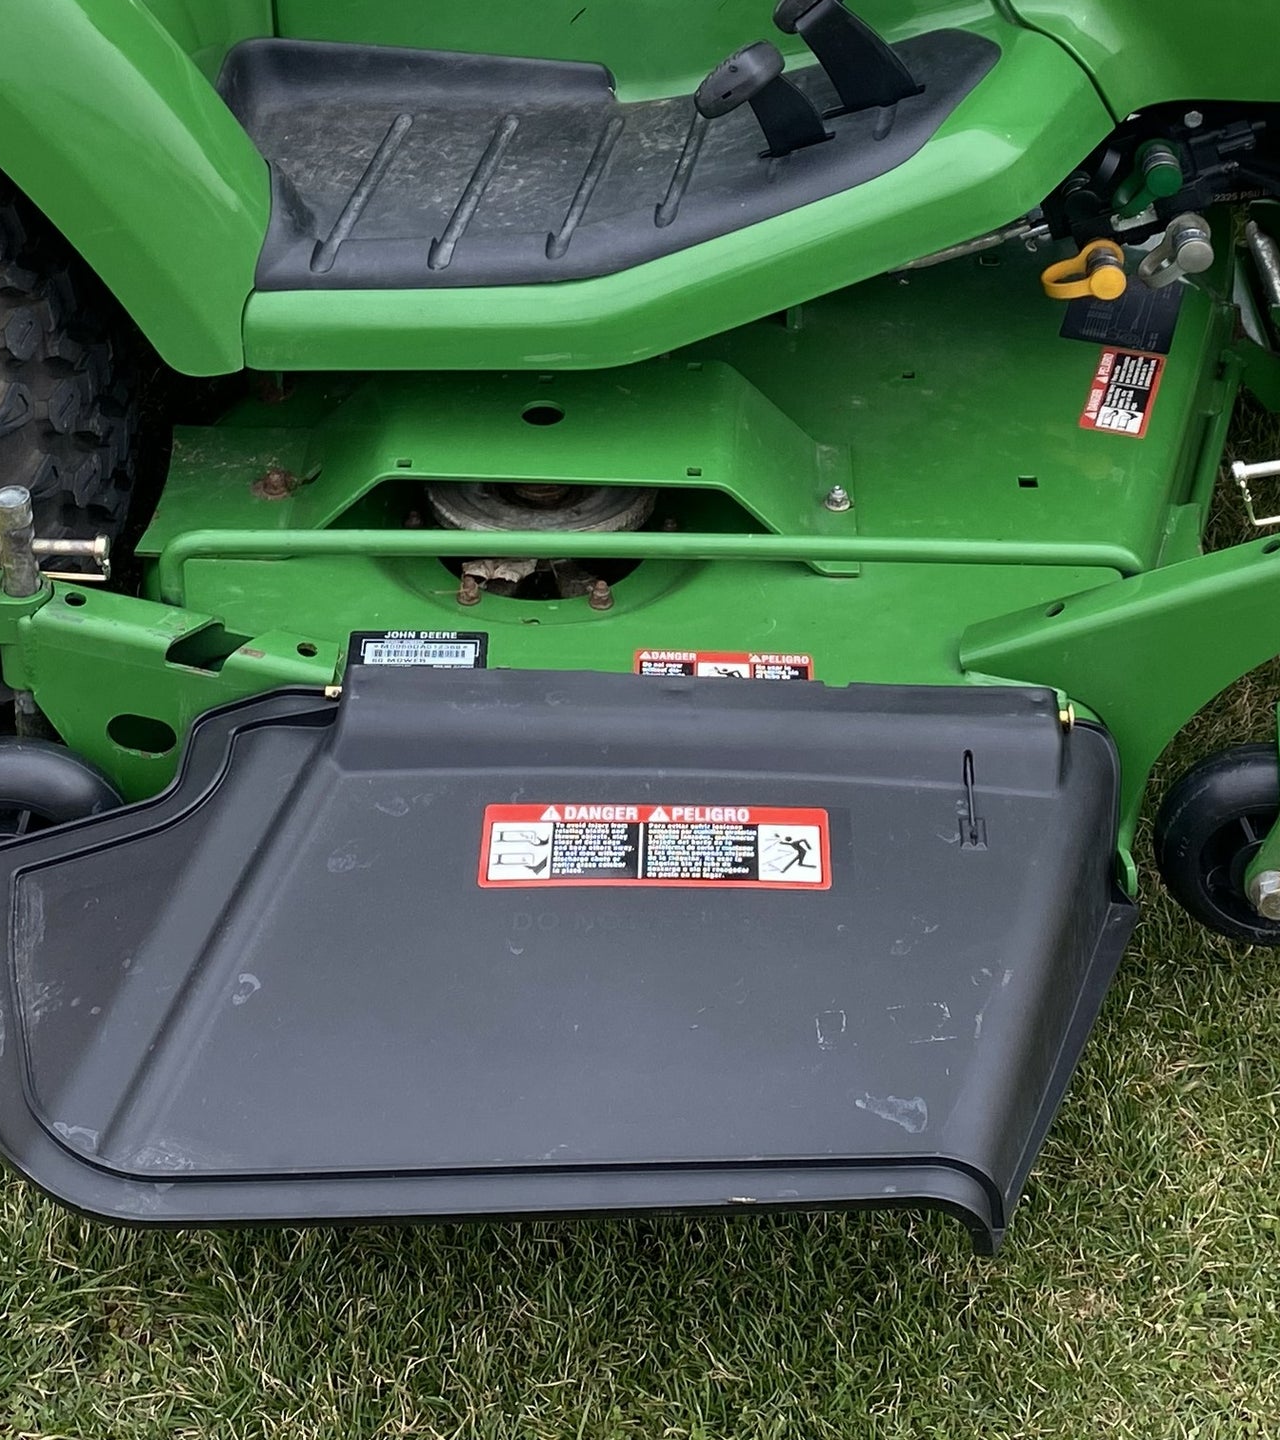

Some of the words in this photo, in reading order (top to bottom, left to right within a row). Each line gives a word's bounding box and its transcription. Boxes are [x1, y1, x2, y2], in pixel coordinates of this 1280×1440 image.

[384, 631, 416, 639] JOHN
[650, 652, 697, 661] DANGER
[761, 654, 809, 664] PELIGRO
[564, 806, 639, 821] DANGER
[671, 807, 749, 822] PELIGRO
